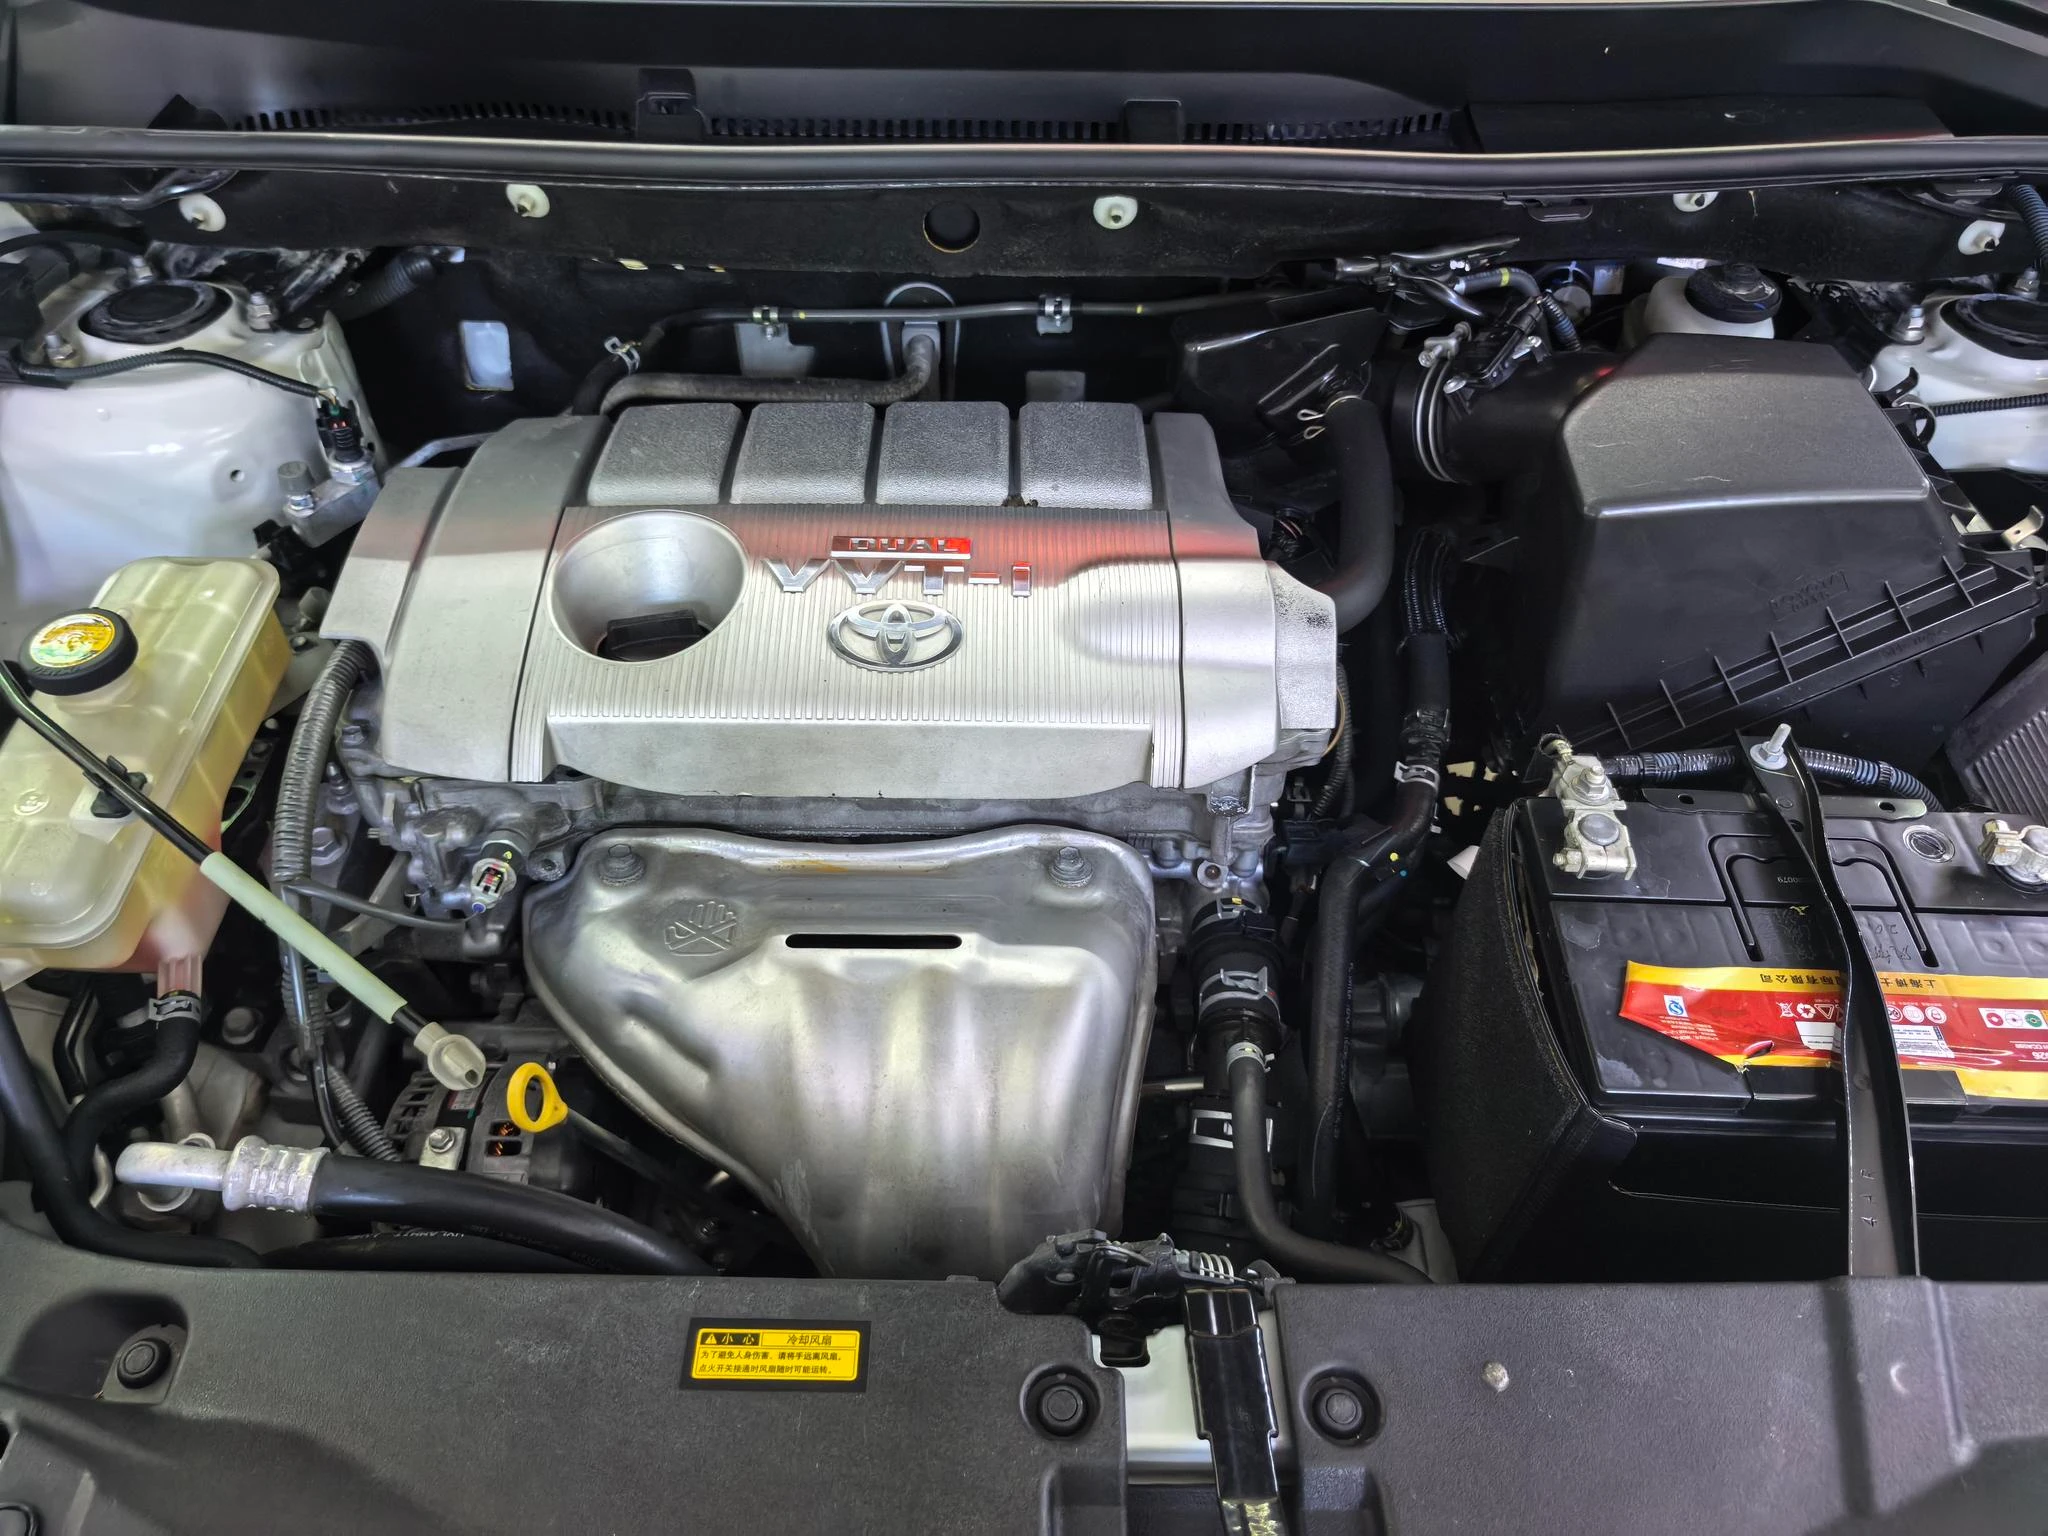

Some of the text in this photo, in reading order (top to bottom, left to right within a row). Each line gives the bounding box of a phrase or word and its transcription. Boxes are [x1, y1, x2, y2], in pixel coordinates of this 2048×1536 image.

[850, 537, 959, 552] DUAL
[786, 1334, 832, 1346] 冷却风扇
